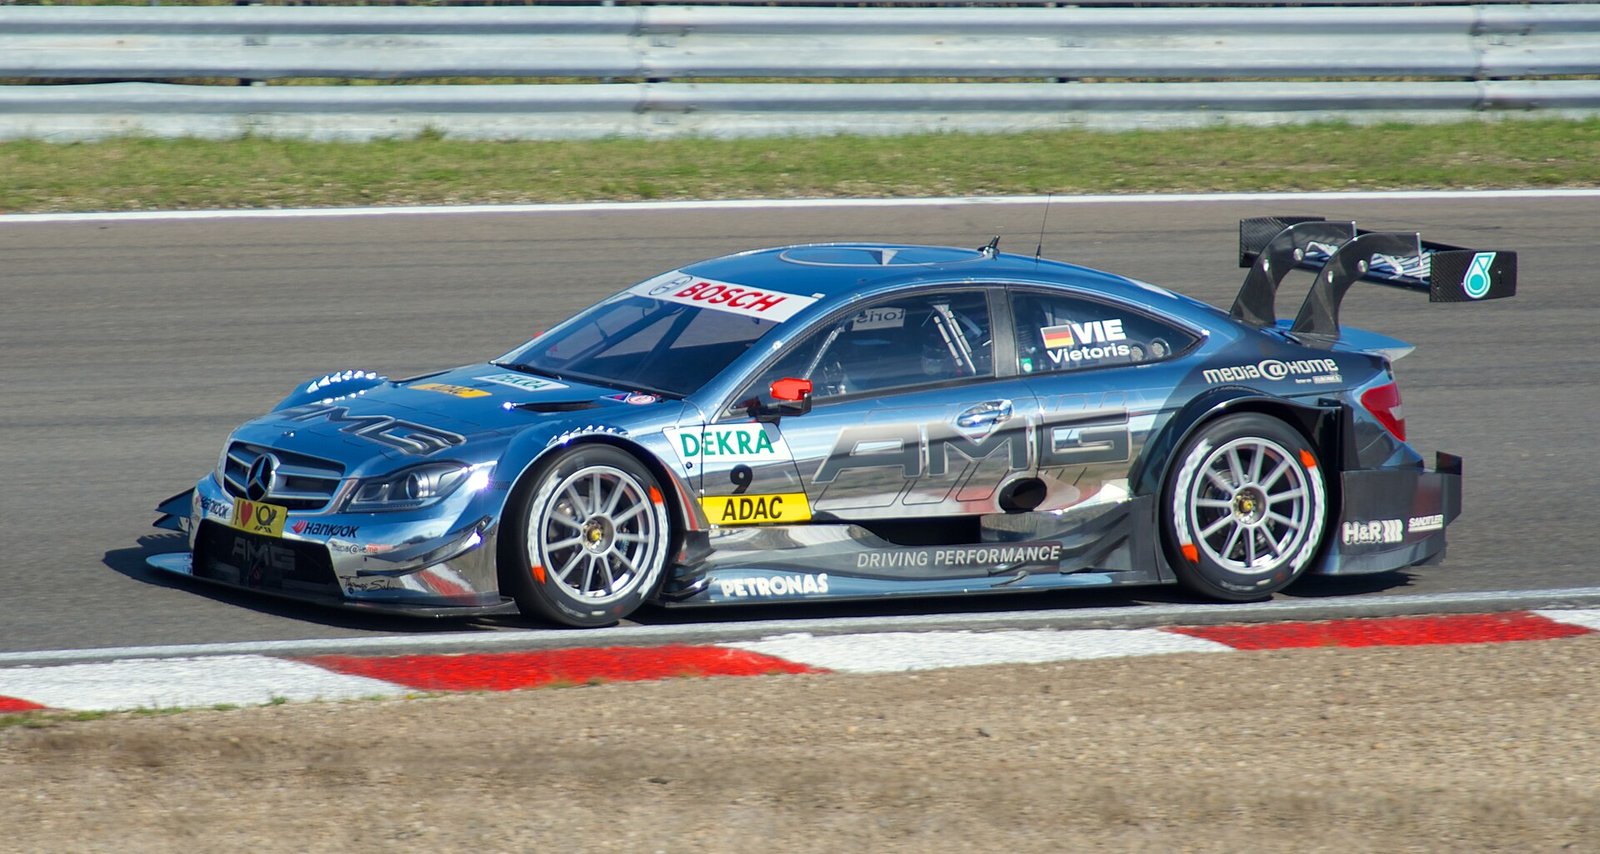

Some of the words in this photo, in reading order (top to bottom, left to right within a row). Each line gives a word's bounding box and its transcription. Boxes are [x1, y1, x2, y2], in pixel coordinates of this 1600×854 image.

[674, 281, 789, 312] BOSCH
[1071, 318, 1127, 345] VIE
[1047, 342, 1131, 364] Vietoris
[680, 429, 774, 457] DEKRA
[811, 406, 1131, 485] AMG
[729, 463, 753, 494] 9
[721, 495, 783, 521] ADAC
[1342, 520, 1383, 545] H&R
[856, 547, 928, 569] DRIVING
[934, 544, 1062, 567] PERFORMANCE
[719, 572, 829, 598] PETRONAS
